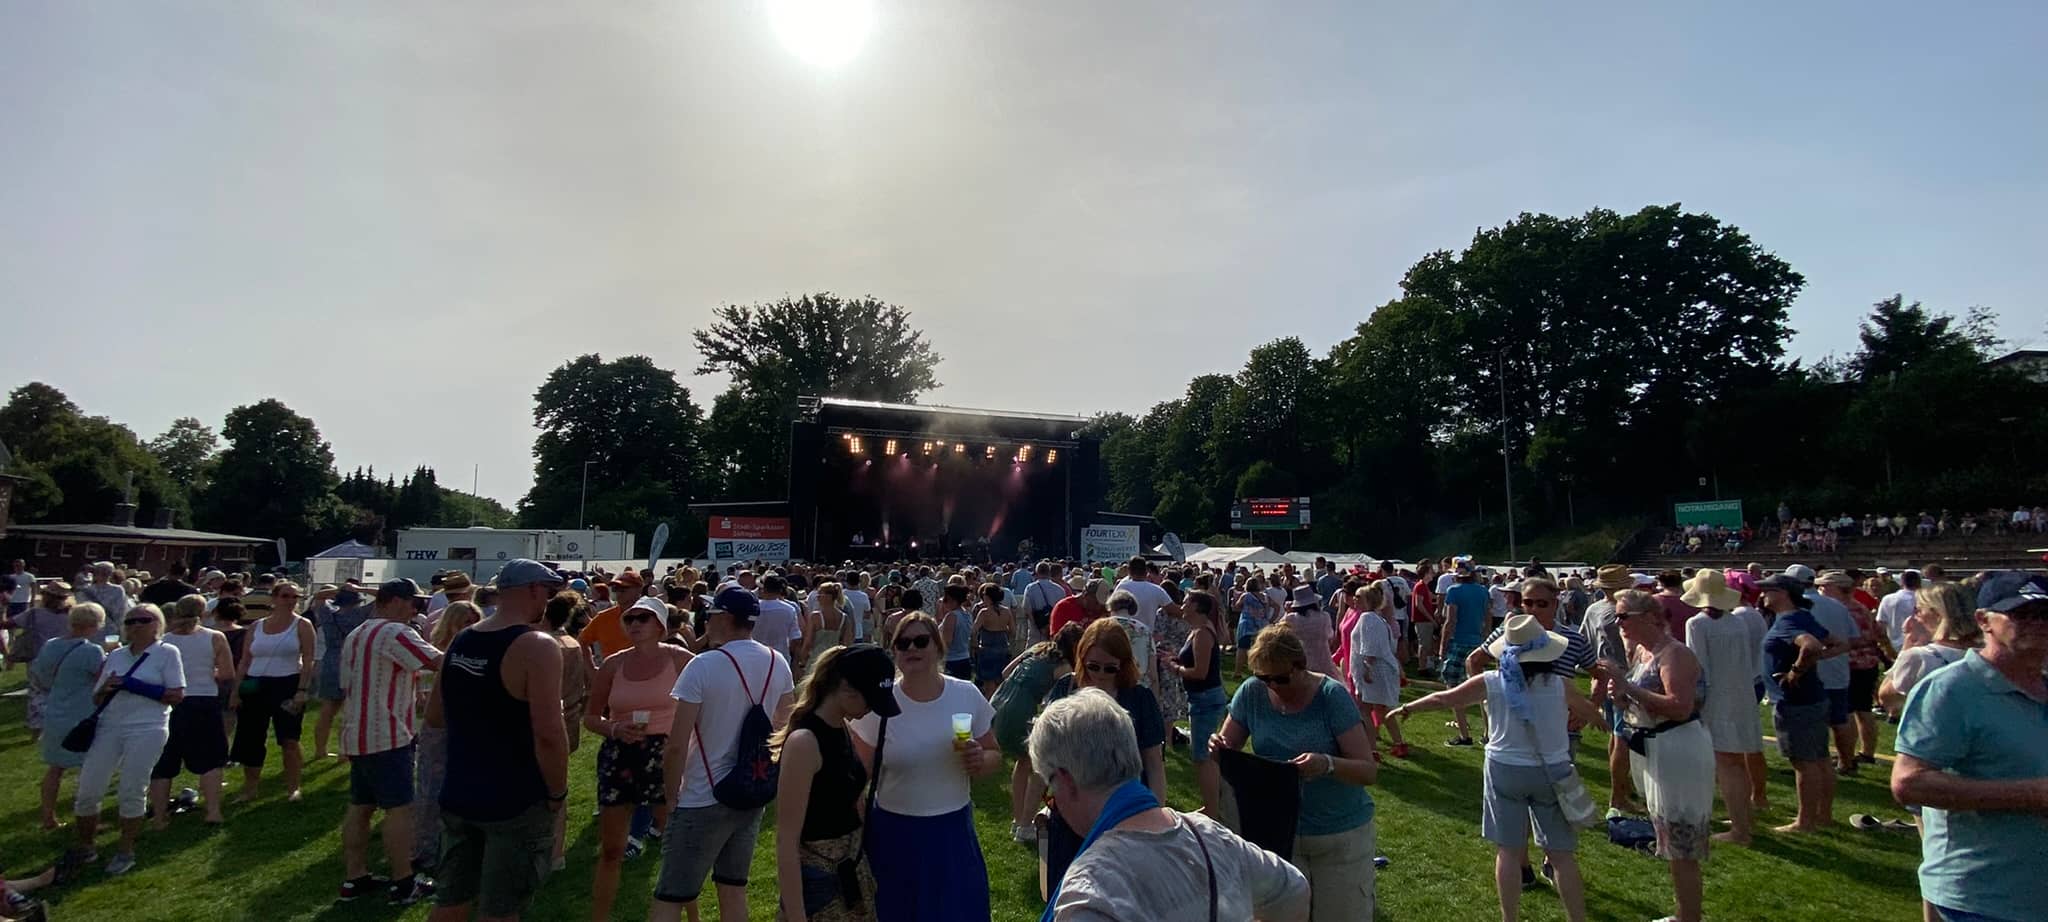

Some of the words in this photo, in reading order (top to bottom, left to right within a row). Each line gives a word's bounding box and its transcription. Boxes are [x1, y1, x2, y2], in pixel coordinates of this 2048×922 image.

[1678, 502, 1738, 513] NOTAUSGANG
[736, 542, 766, 553] RADIO
[405, 550, 438, 560] THW
